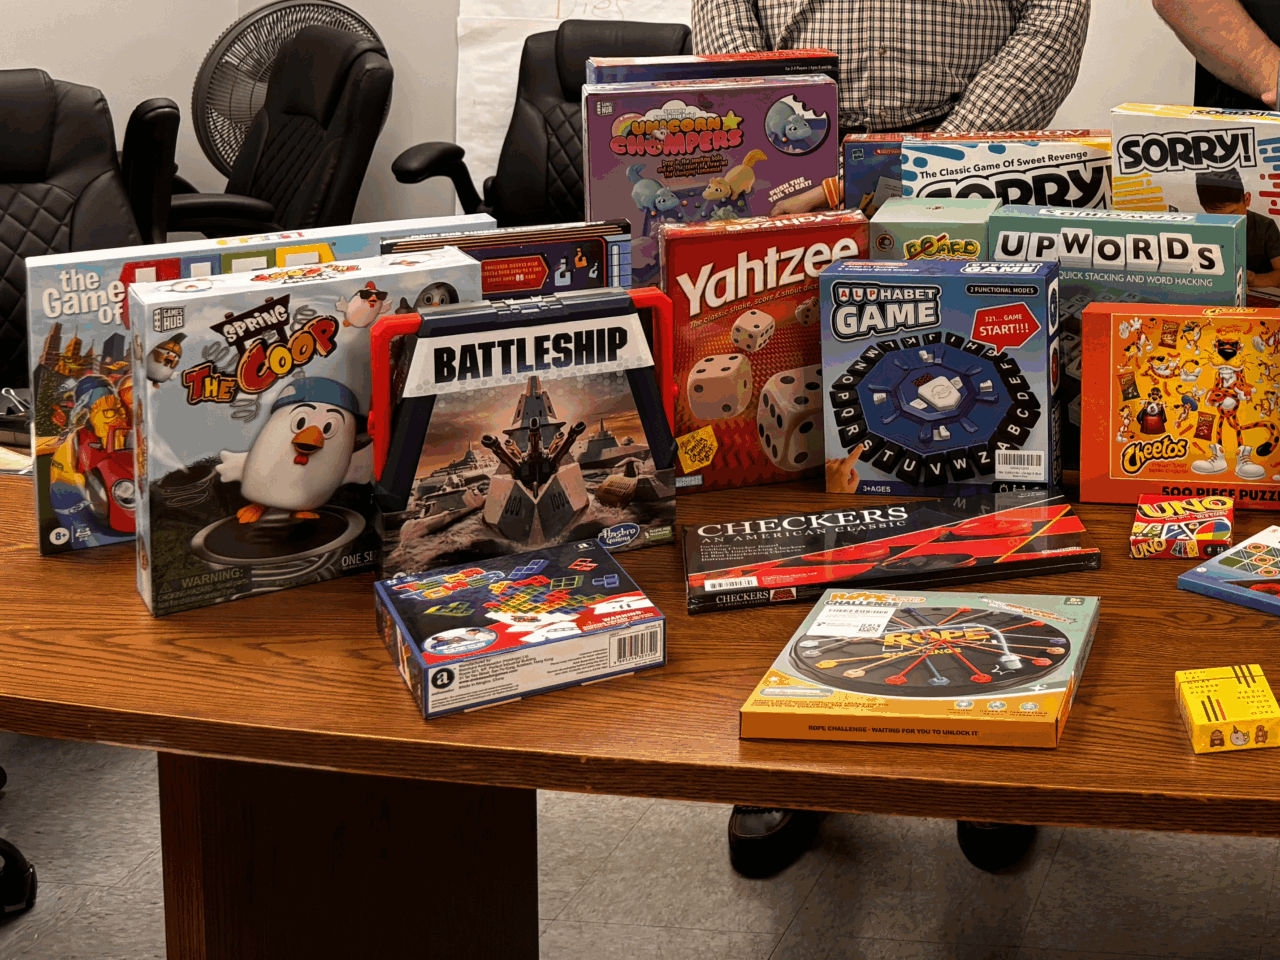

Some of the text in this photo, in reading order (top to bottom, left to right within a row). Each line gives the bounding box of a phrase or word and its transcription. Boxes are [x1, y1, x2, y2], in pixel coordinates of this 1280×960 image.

[631, 117, 721, 134] UNICORN
[609, 130, 743, 156] CHOMPERS
[1120, 129, 1253, 170] SORRY!
[920, 151, 1088, 179] The Classic Game Sweet Revenge
[768, 180, 812, 203] TAIL EAT!
[769, 177, 805, 196] PUSH THE
[1000, 230, 1217, 271] UPWORDS
[59, 269, 100, 291] the
[676, 238, 859, 317] Yahtzee
[1058, 270, 1213, 288] QUICK STACKING WORD HACKING
[42, 280, 125, 318] Game
[840, 289, 936, 301] ALPHABET
[690, 287, 802, 328] The classic score shout
[836, 302, 935, 335] GAME
[979, 323, 1029, 337] START!!!
[240, 316, 337, 393] COOP
[433, 326, 628, 384] BATTLESHIP
[184, 366, 236, 402] THE
[1121, 435, 1188, 475] Cheetos
[1139, 497, 1234, 518] UNO
[602, 528, 636, 538] Hasbro
[697, 506, 909, 538] CHECKERS
[728, 520, 907, 543] AMERICAN CLASSIC
[606, 536, 631, 544] Gaming
[1131, 540, 1166, 558] UNO
[181, 568, 244, 589] WARNING:
[716, 591, 768, 604] CHECKERS
[823, 599, 902, 608] CHALLENGE
[883, 628, 991, 648] ROPE
[828, 725, 867, 733] CHALLENGE
[916, 728, 931, 736] YOU
